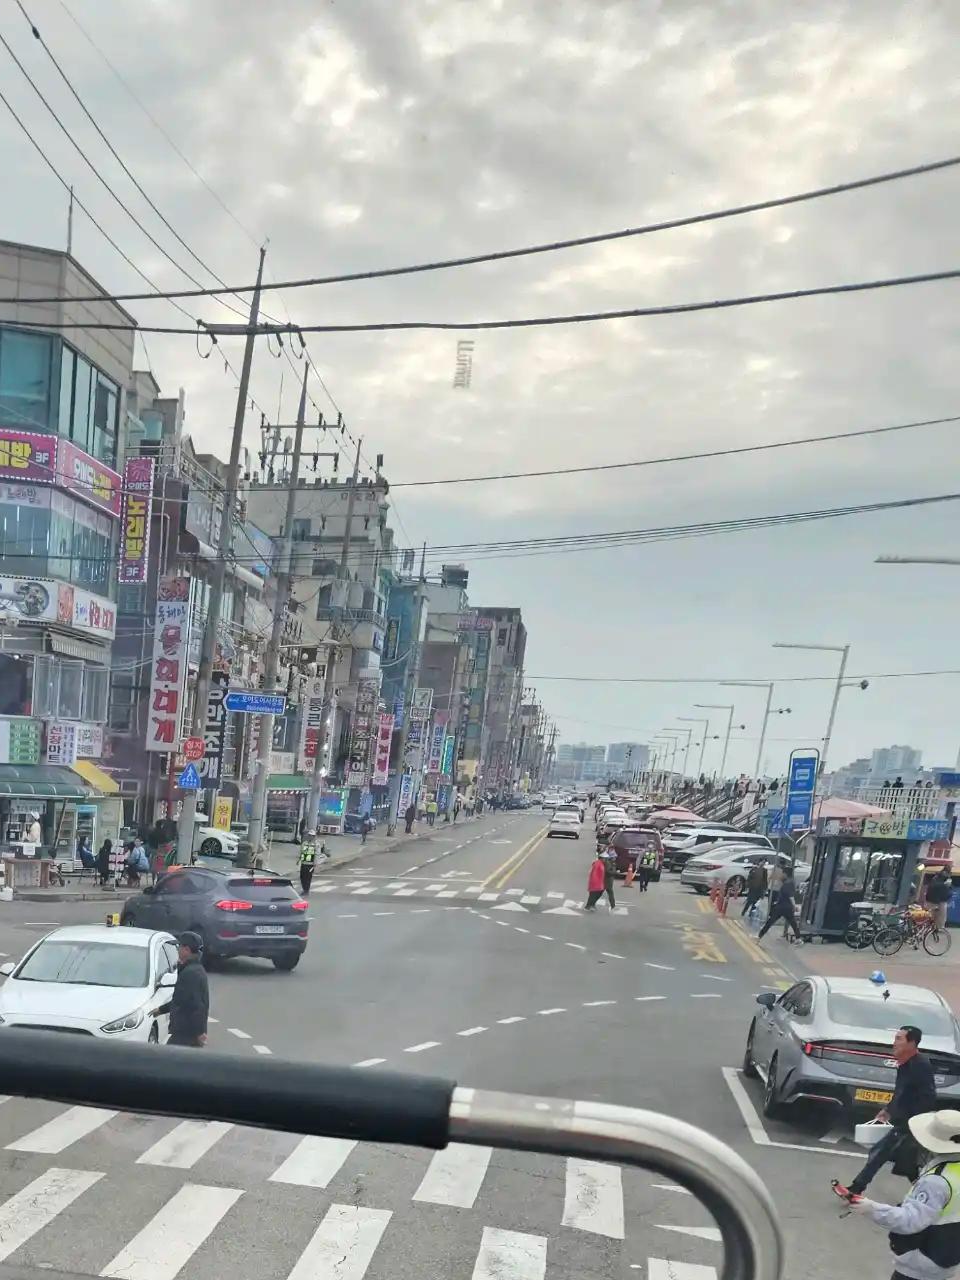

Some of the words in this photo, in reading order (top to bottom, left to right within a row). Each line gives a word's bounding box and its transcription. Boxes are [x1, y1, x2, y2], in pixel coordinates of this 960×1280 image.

[36, 451, 50, 463] 3F
[125, 494, 146, 560] 노래방
[126, 567, 139, 577] 3F
[47, 725, 61, 764] 선창마트
